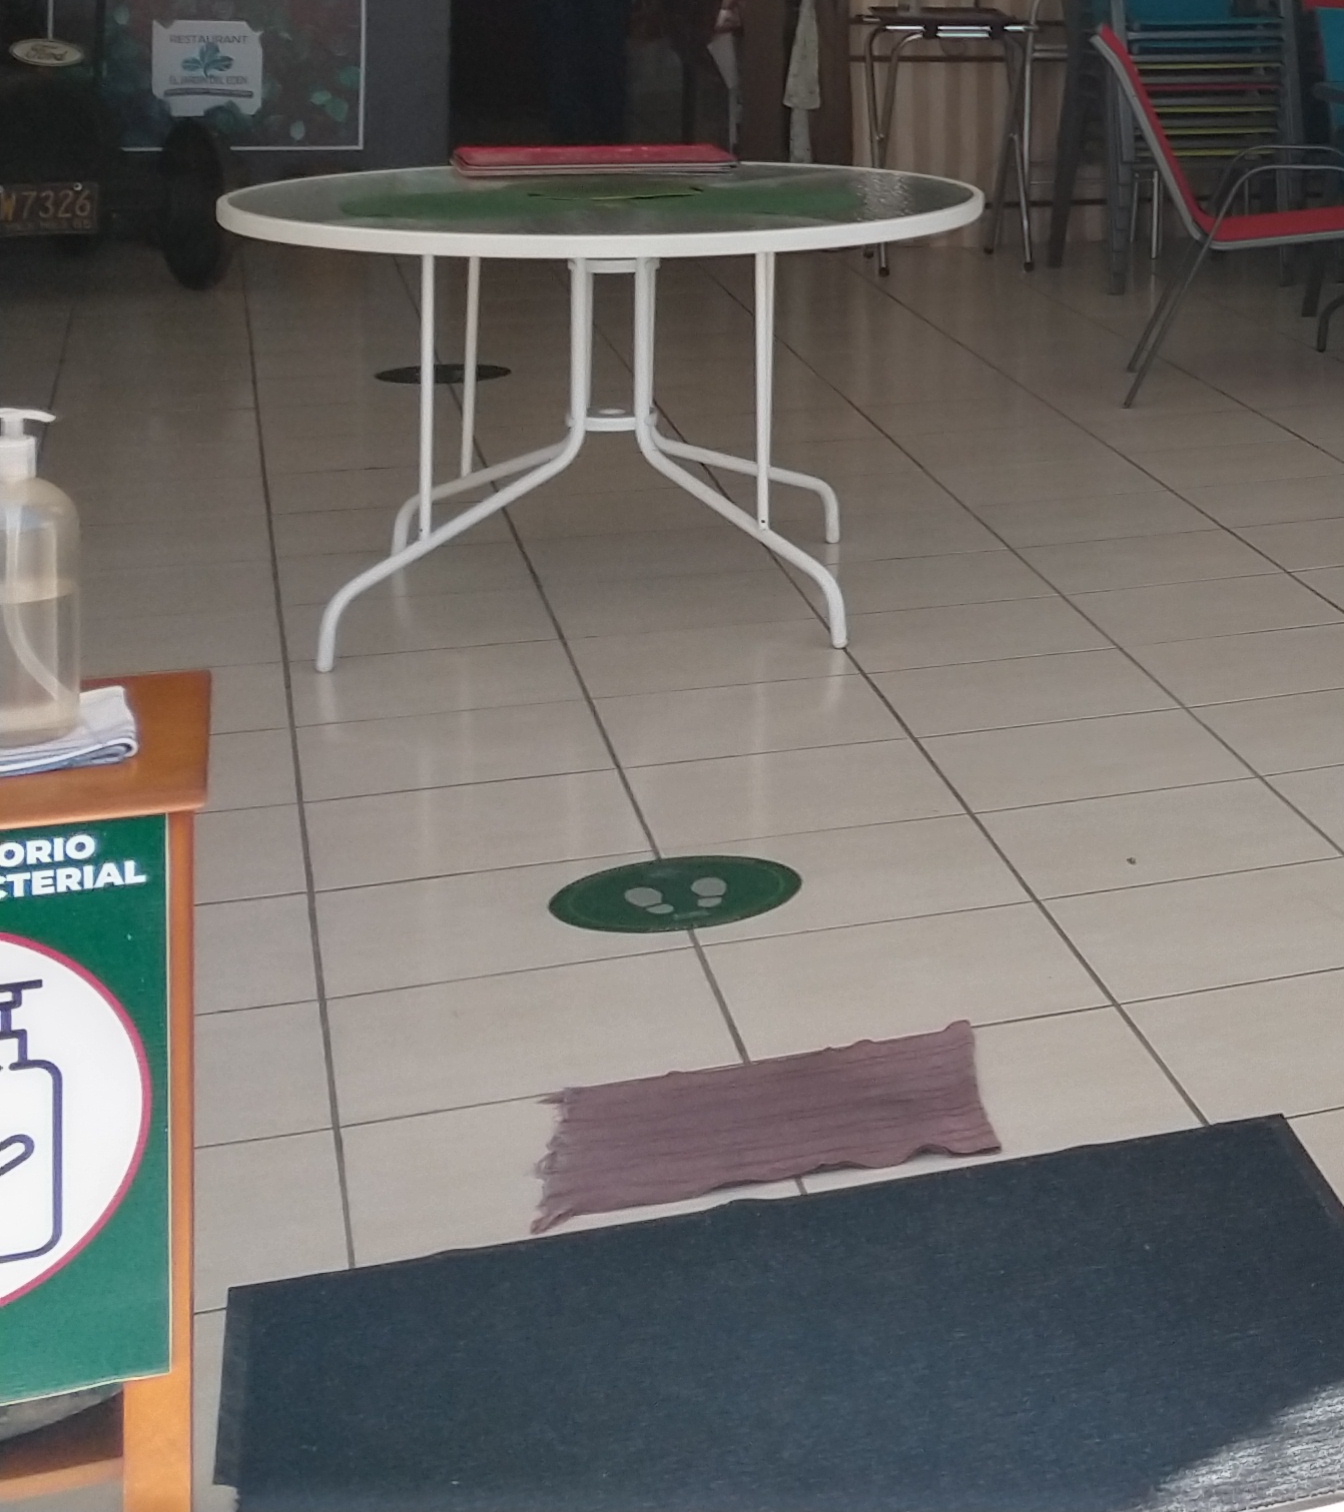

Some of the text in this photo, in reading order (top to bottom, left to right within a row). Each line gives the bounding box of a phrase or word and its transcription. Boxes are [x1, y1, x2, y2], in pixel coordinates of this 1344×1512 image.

[169, 34, 248, 44] RESTAURANT
[0, 834, 96, 868] ORIO
[0, 859, 147, 902] TERIAL
